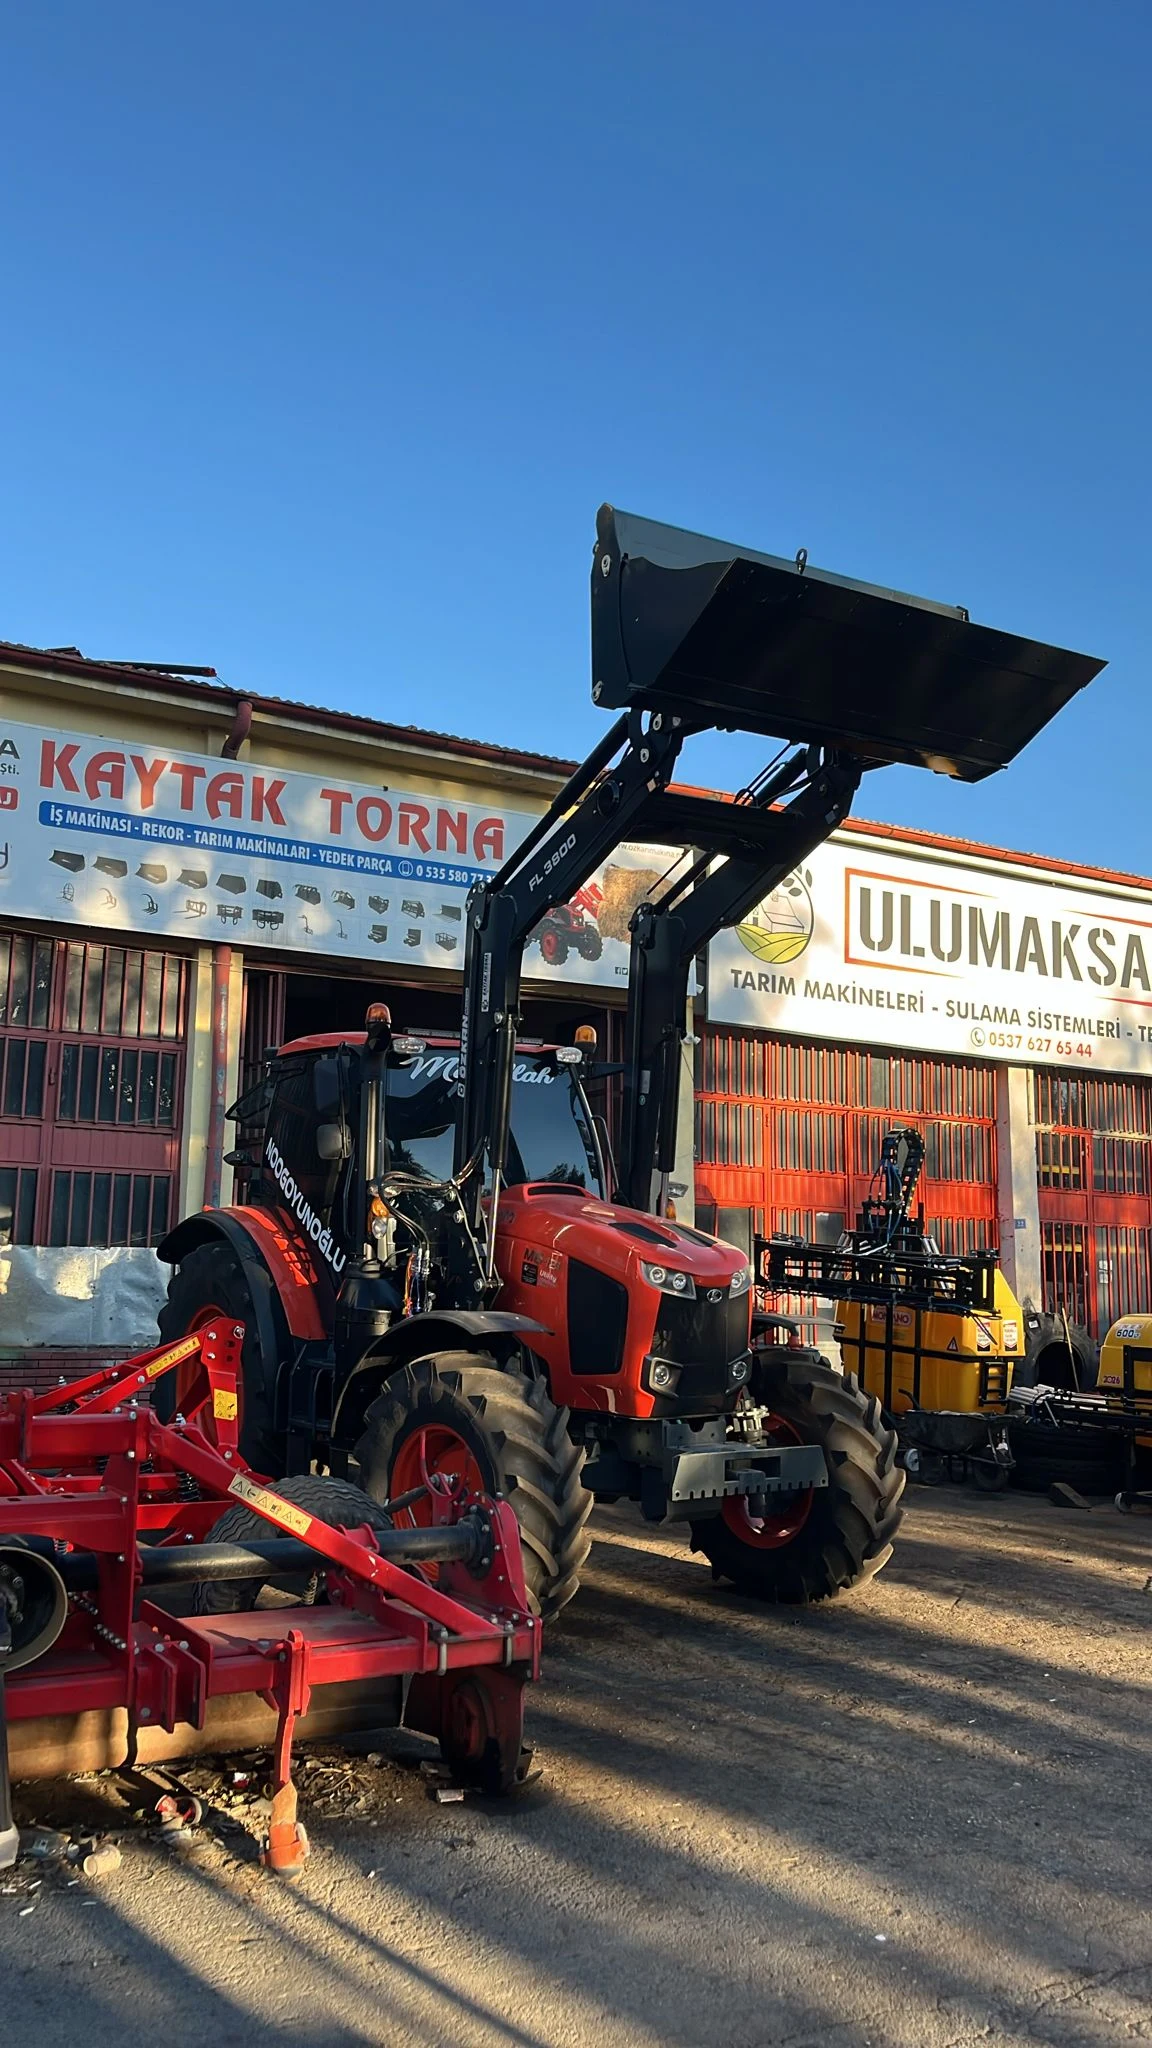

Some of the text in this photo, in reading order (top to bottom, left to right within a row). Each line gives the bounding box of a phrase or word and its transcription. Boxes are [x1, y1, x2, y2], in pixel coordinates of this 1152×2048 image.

[40, 739, 505, 862] KAYTAK TORNA
[50, 804, 63, 826] İŞ
[65, 810, 131, 834] MAKİNASI
[142, 823, 184, 842] REKOR
[194, 830, 233, 849] TARIM
[235, 836, 310, 860] MAKİNALARI
[319, 849, 355, 868] YEDEK
[357, 855, 392, 875] PARÇA
[416, 864, 422, 877] 0
[425, 866, 446, 880] 535
[448, 869, 468, 883] 580
[528, 833, 577, 892] FL 3800
[859, 886, 1152, 992] ULUMAKSA
[730, 968, 796, 996] TARIM
[803, 979, 924, 1013] MAKİNELERİ
[945, 999, 1021, 1026] SULAMA
[1027, 1006, 1121, 1039] SİSTEMLERİ
[1138, 1025, 1152, 1043] TE
[989, 1031, 1092, 1058] 0537 627 65 44
[1116, 1329, 1135, 1338] 600
